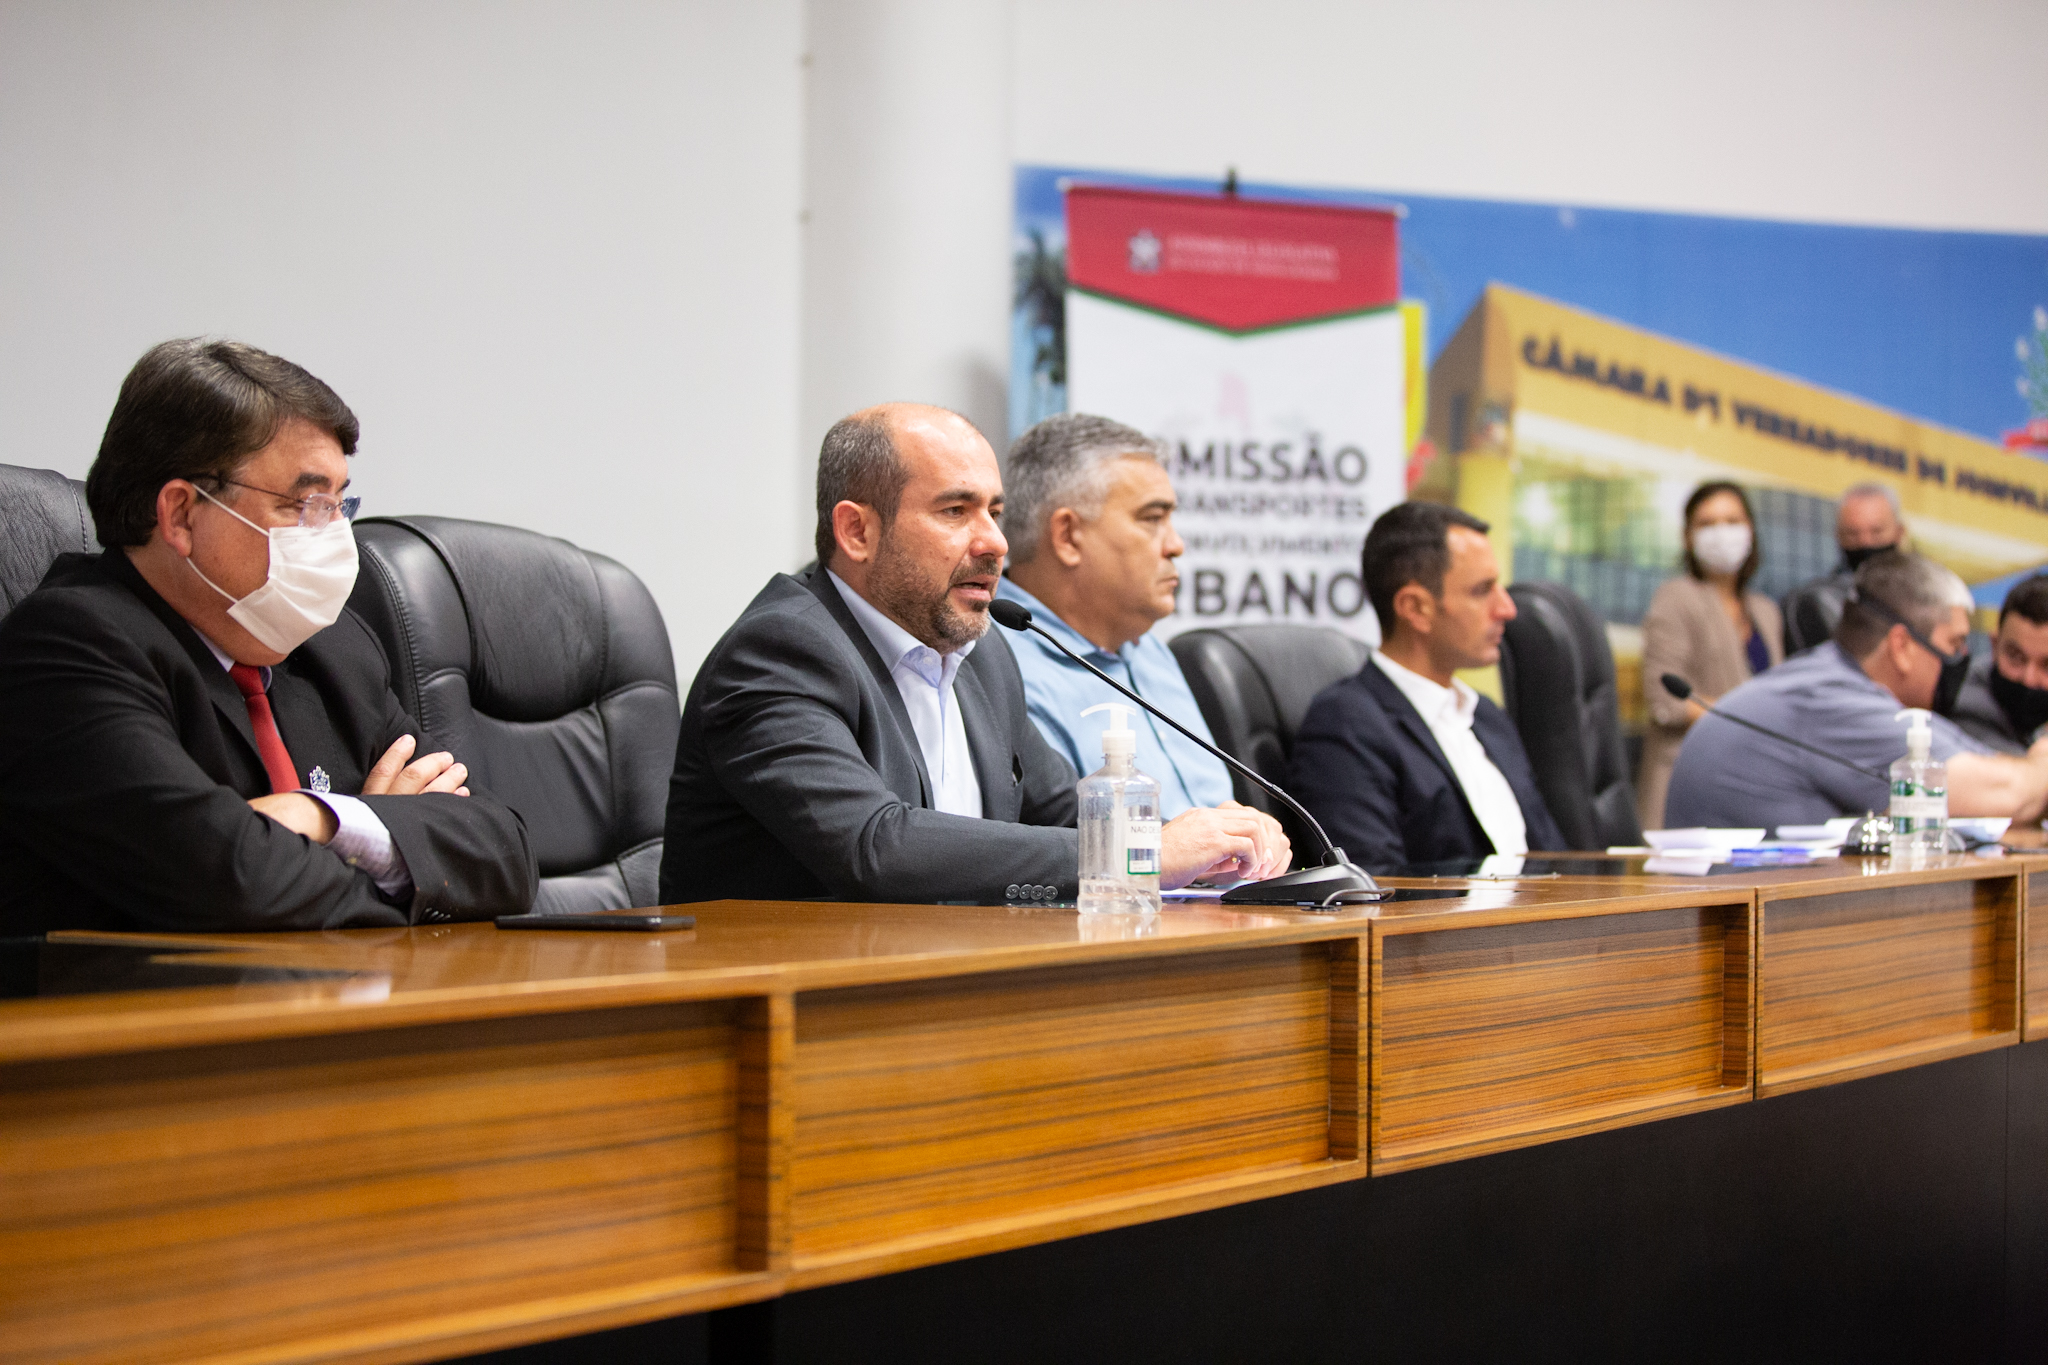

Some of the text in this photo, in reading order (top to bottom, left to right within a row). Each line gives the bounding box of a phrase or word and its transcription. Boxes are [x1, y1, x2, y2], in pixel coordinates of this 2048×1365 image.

[1521, 332, 1671, 405] CÂMARA
[1165, 433, 1368, 484] MISSÃO
[1176, 492, 1367, 518] RANSPORTES
